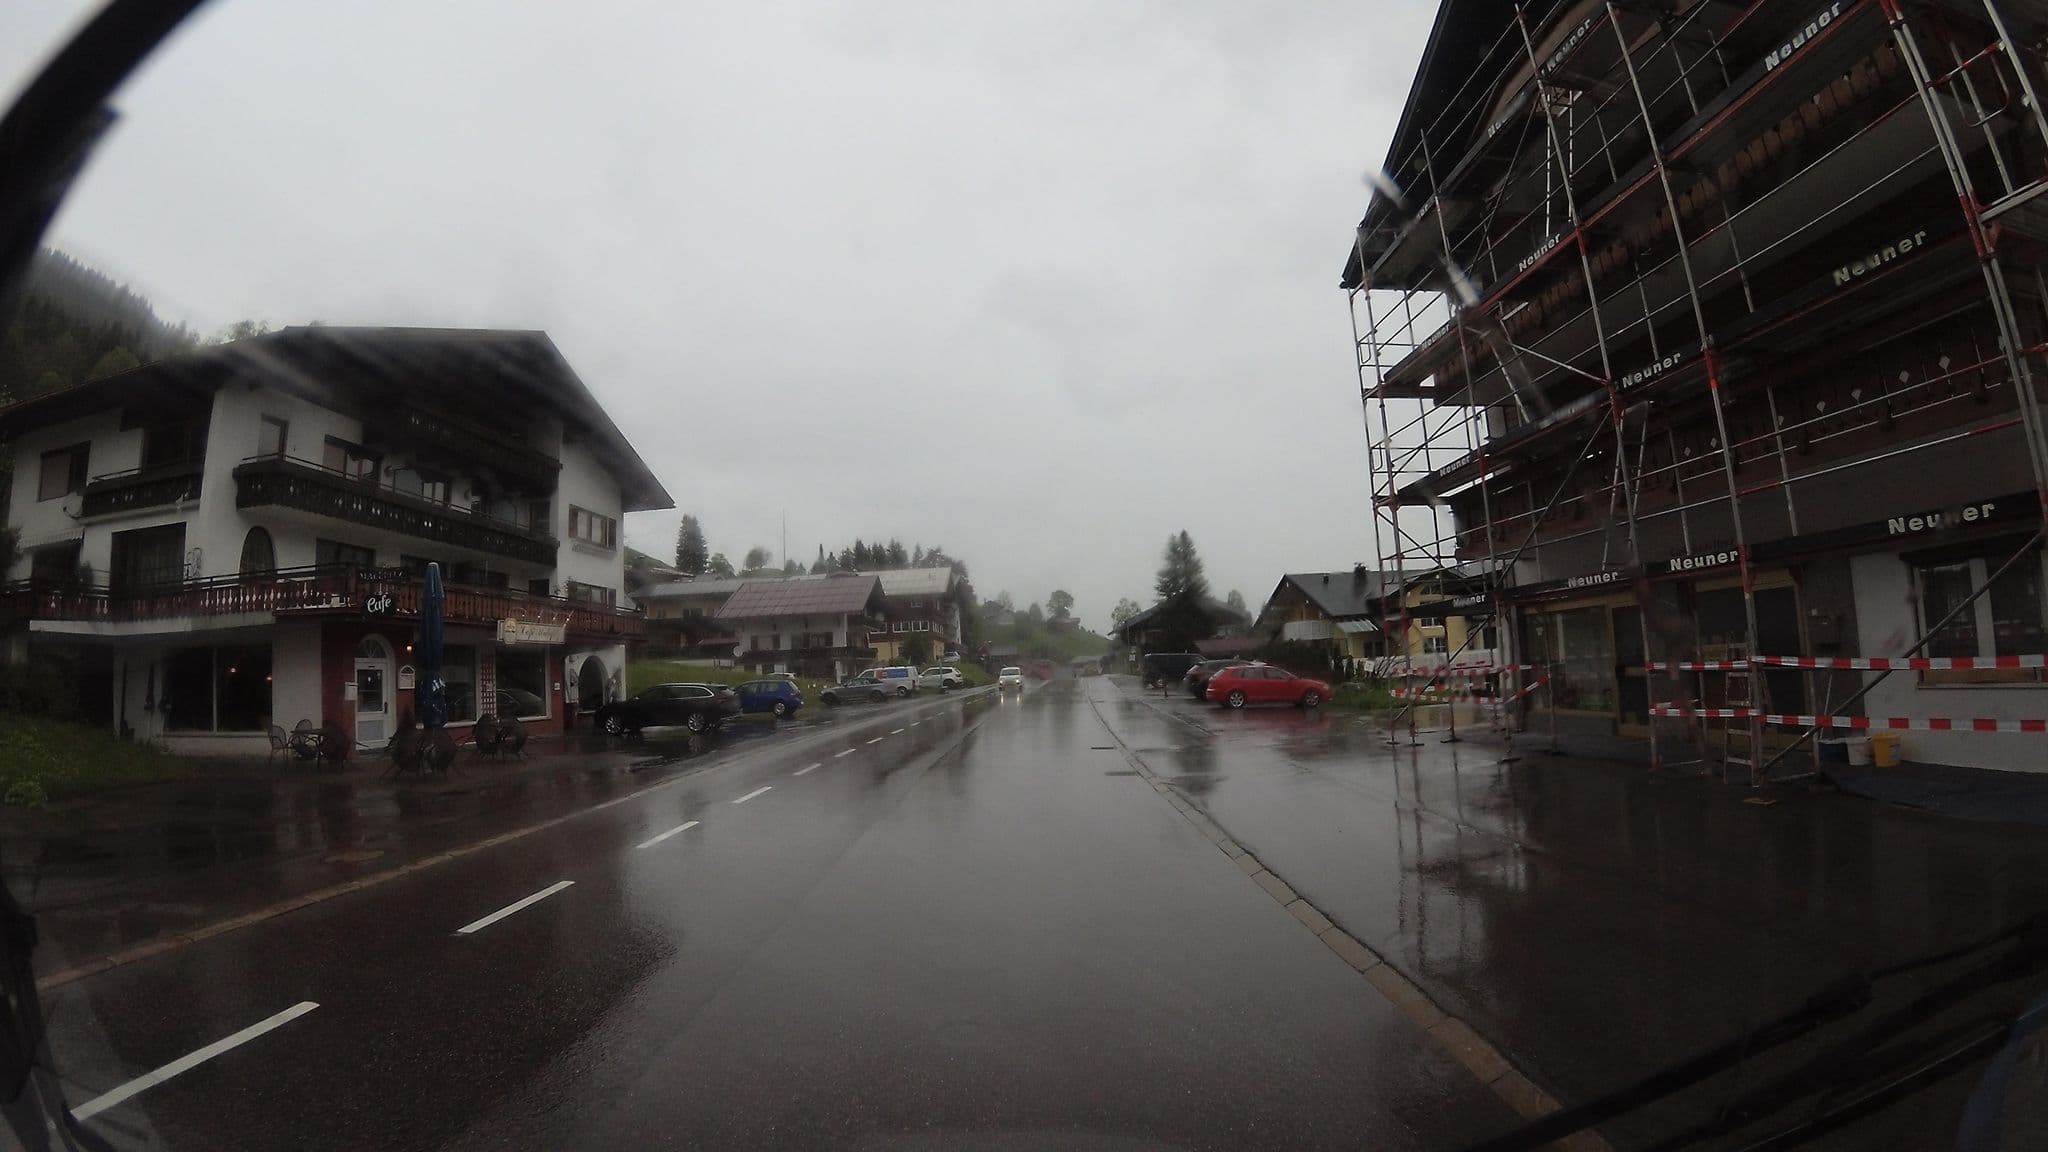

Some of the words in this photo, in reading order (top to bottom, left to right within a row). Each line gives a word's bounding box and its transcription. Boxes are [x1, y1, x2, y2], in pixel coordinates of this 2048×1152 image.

[1764, 2, 1840, 71] Neuner
[1519, 233, 1560, 272] Neuner
[1832, 231, 1927, 286] Neuner
[1622, 352, 1681, 388] Neuner
[1567, 570, 1618, 588] Neuner
[1671, 550, 1738, 571] Neuner
